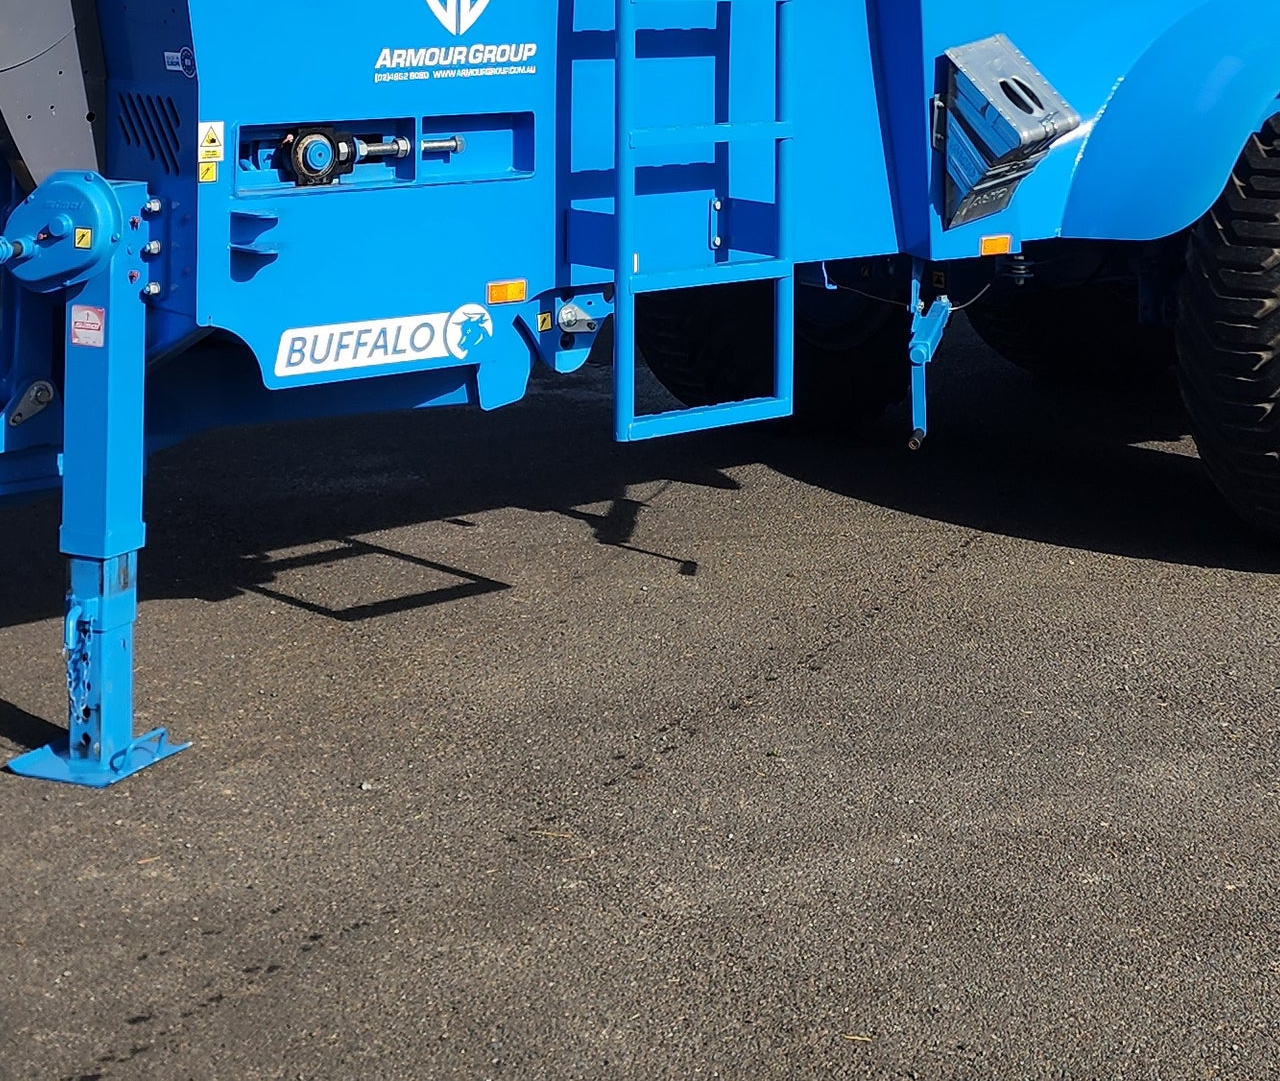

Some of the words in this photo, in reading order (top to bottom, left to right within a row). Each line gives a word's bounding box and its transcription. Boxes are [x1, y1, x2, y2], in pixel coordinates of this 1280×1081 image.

[374, 46, 467, 68] ARMOUR
[469, 42, 538, 64] GROUP
[285, 322, 435, 368] BUFFALO
